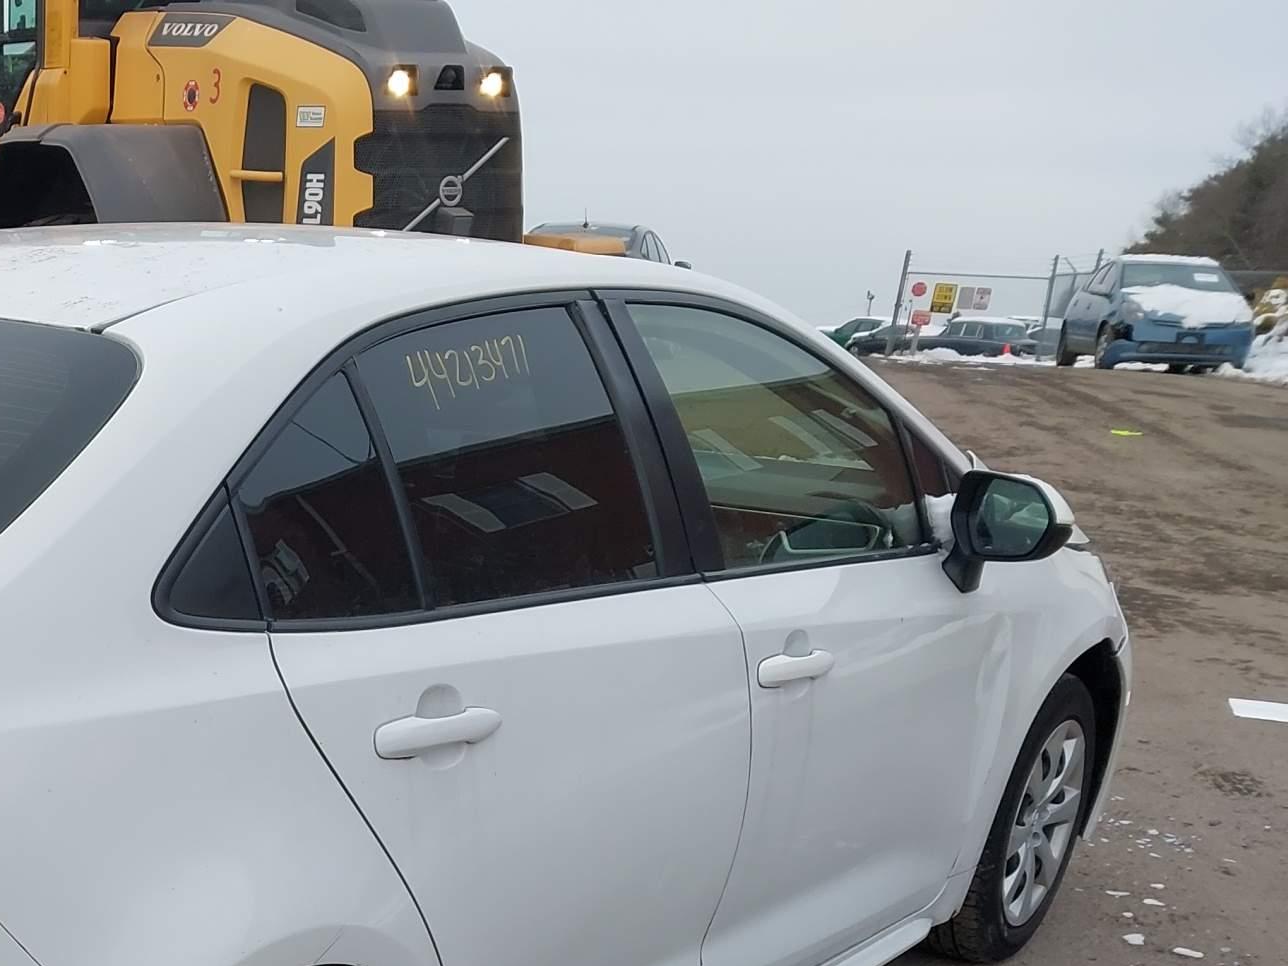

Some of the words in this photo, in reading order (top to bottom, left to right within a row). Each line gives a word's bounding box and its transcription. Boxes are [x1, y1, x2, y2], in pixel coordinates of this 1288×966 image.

[161, 22, 219, 37] VOLVO
[209, 67, 222, 105] 3
[302, 173, 326, 225] L90H
[406, 334, 530, 410] 44213471
